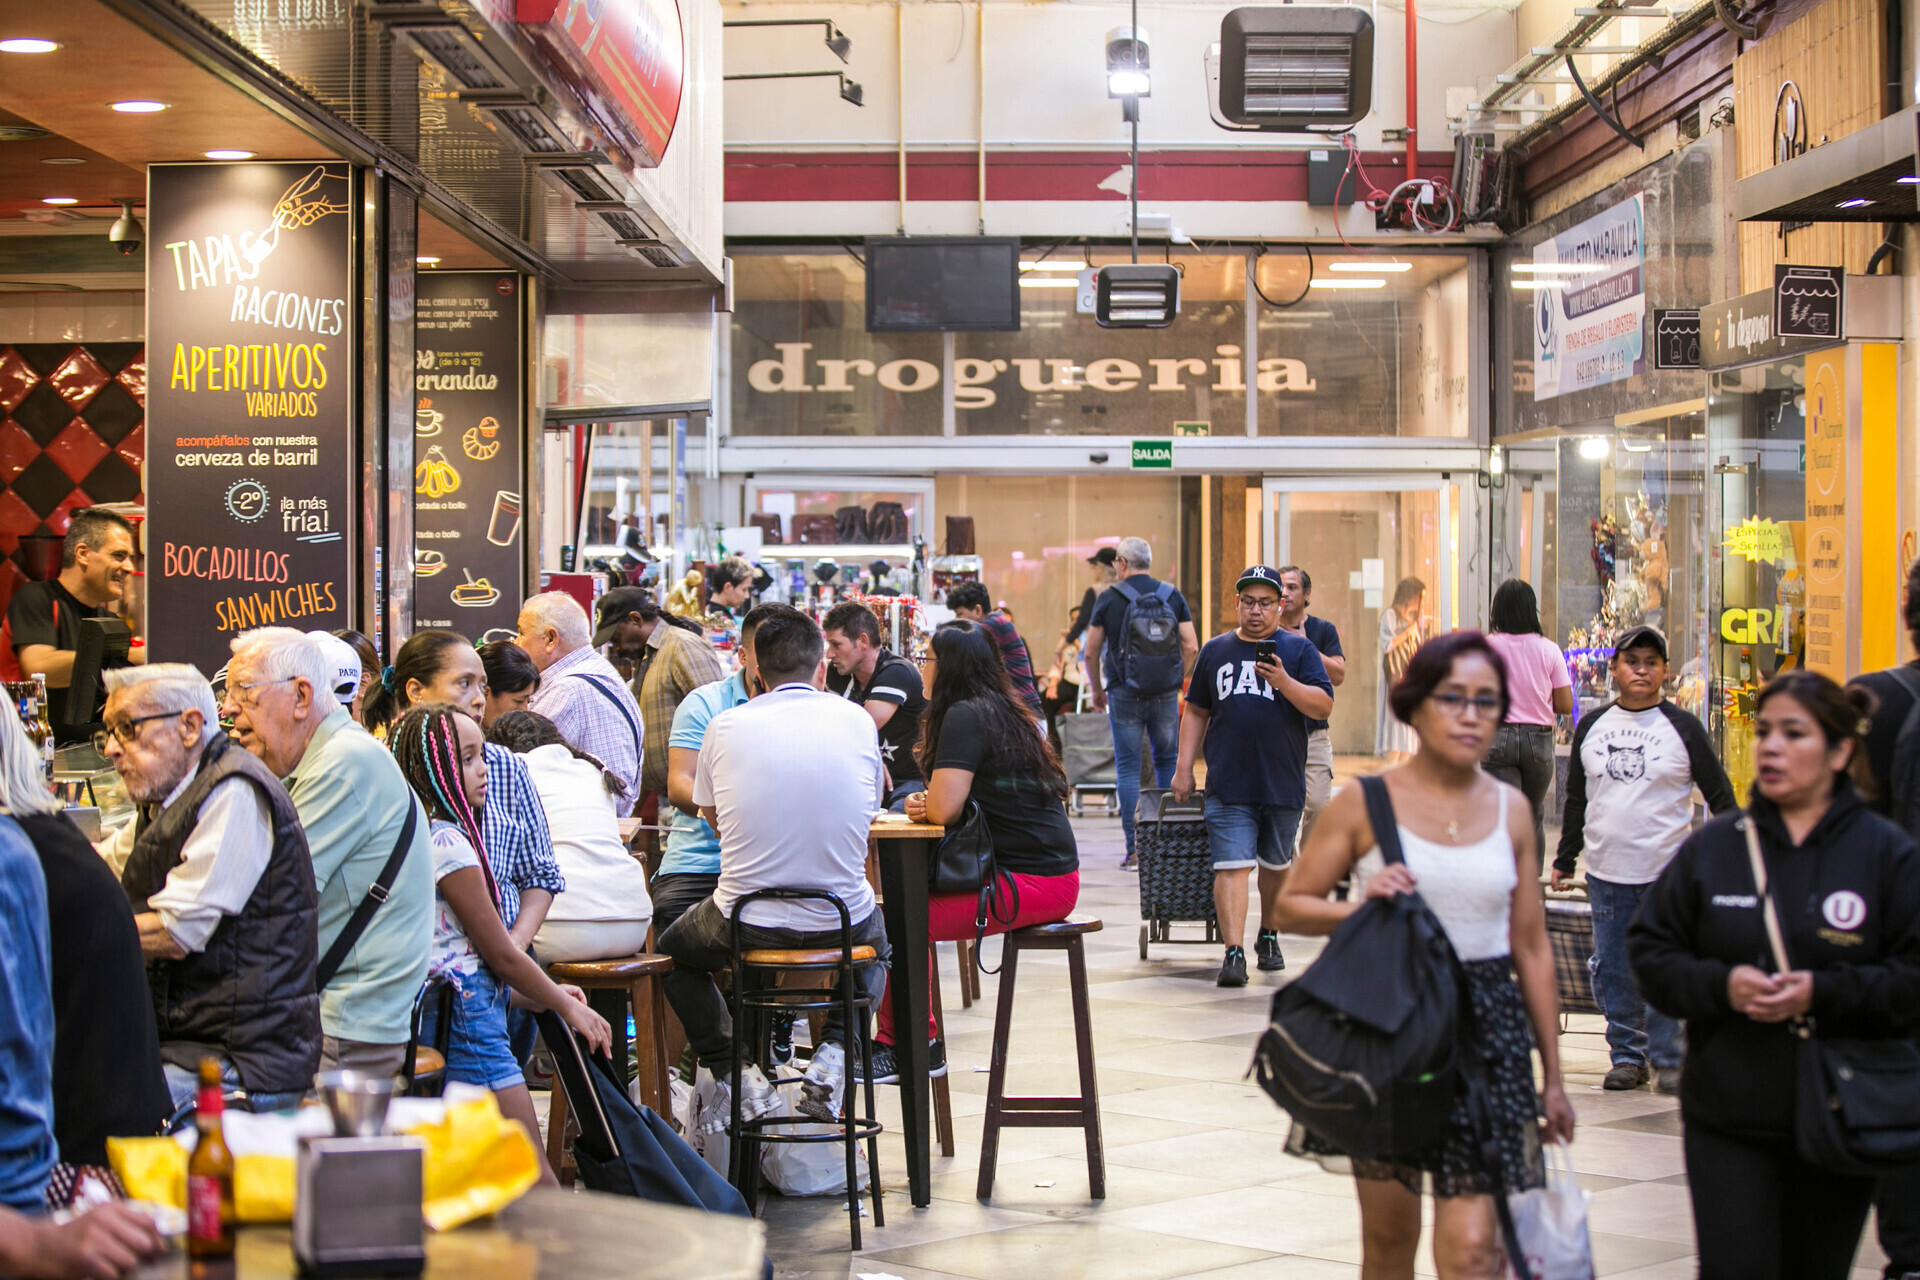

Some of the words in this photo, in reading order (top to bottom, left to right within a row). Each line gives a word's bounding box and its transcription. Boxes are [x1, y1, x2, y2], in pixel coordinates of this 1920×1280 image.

[1593, 217, 1638, 270] MARAVILLA
[165, 231, 260, 291] TAPAS
[231, 285, 345, 336] RACIONES
[170, 342, 328, 392] APERITIVOS
[416, 366, 498, 391] eriendas
[748, 342, 1316, 409] drogueria
[246, 391, 318, 417] VARIADOS
[176, 434, 250, 449] acompáñalos
[252, 436, 274, 447] con
[275, 434, 318, 447] nuestra
[175, 452, 244, 467] cerveza
[247, 448, 271, 466] de
[273, 448, 318, 466] barril
[1133, 448, 1171, 460] SALIDA
[298, 496, 328, 510] más
[441, 502, 447, 510] o
[282, 510, 329, 532] fría!
[1736, 528, 1779, 537] ESPECIAS
[435, 531, 441, 539] o
[164, 542, 291, 584] BOCADILLOS
[215, 581, 337, 631] SANWICHES
[423, 619, 431, 627] la
[1599, 731, 1615, 743] LOS
[1621, 729, 1661, 746] ANGELES
[1835, 899, 1854, 923] U
